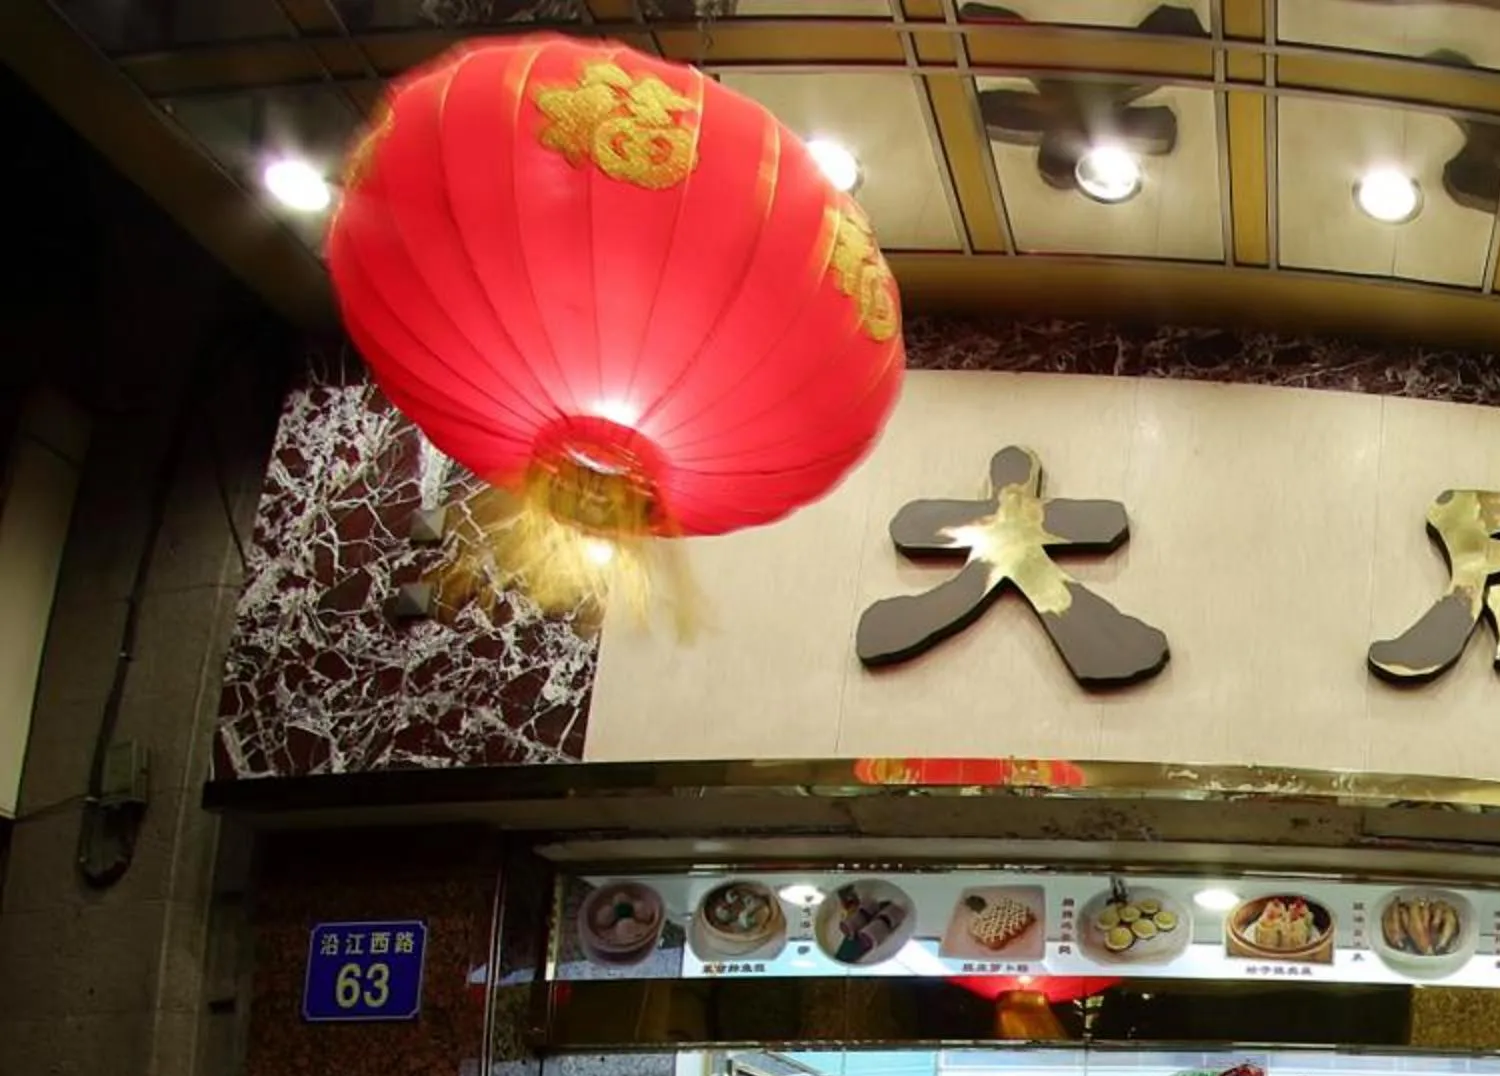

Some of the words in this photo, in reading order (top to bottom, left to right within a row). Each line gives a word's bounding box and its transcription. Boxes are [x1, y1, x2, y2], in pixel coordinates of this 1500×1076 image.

[320, 931, 415, 955] 沿江西路
[335, 962, 391, 1009] 63
